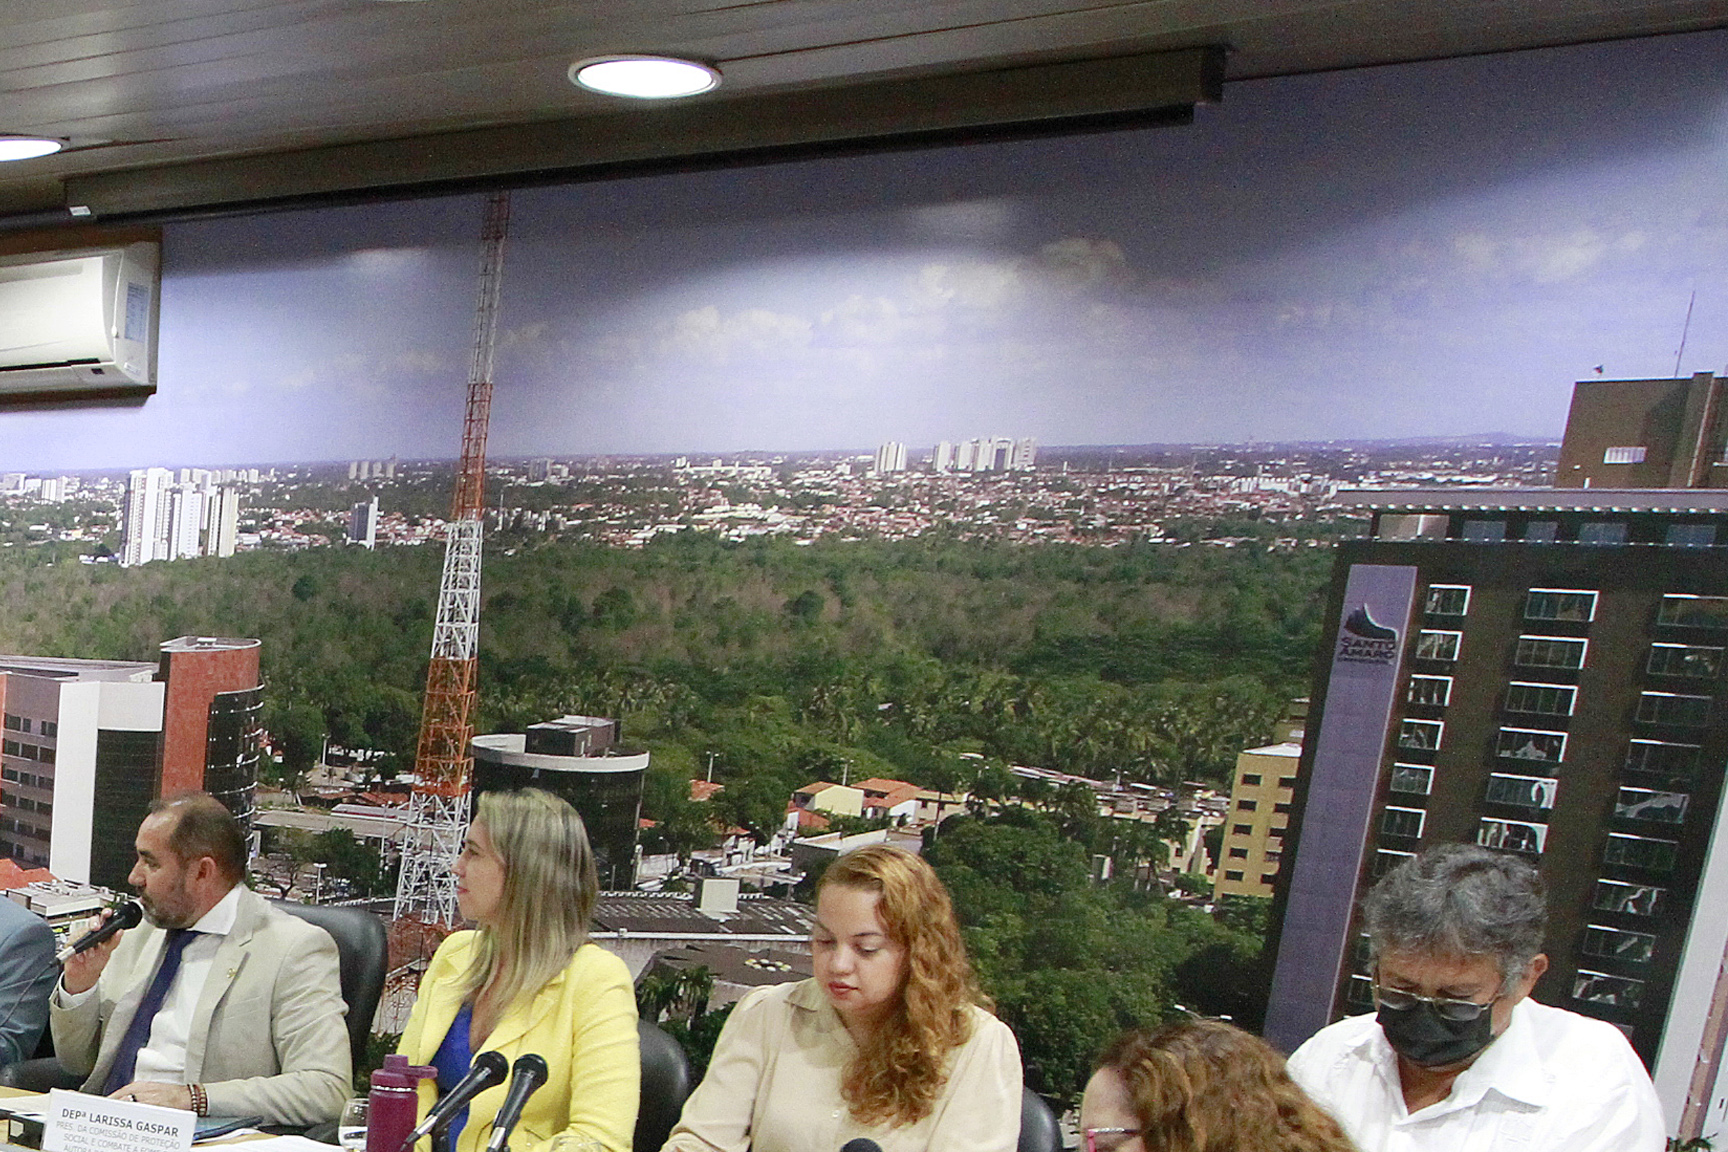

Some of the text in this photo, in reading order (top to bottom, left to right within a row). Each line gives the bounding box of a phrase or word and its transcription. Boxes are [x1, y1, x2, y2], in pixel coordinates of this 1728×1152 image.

[56, 1120, 180, 1150] PRES. DA COMISSÃO DE PROTEÇÃO
[89, 1113, 133, 1129] LARISSA
[136, 1121, 179, 1137] GASPAR
[64, 1133, 89, 1144] SOCIAL
[90, 1137, 96, 1146] E
[97, 1139, 131, 1152] COMBATE
[133, 1144, 139, 1152] A
